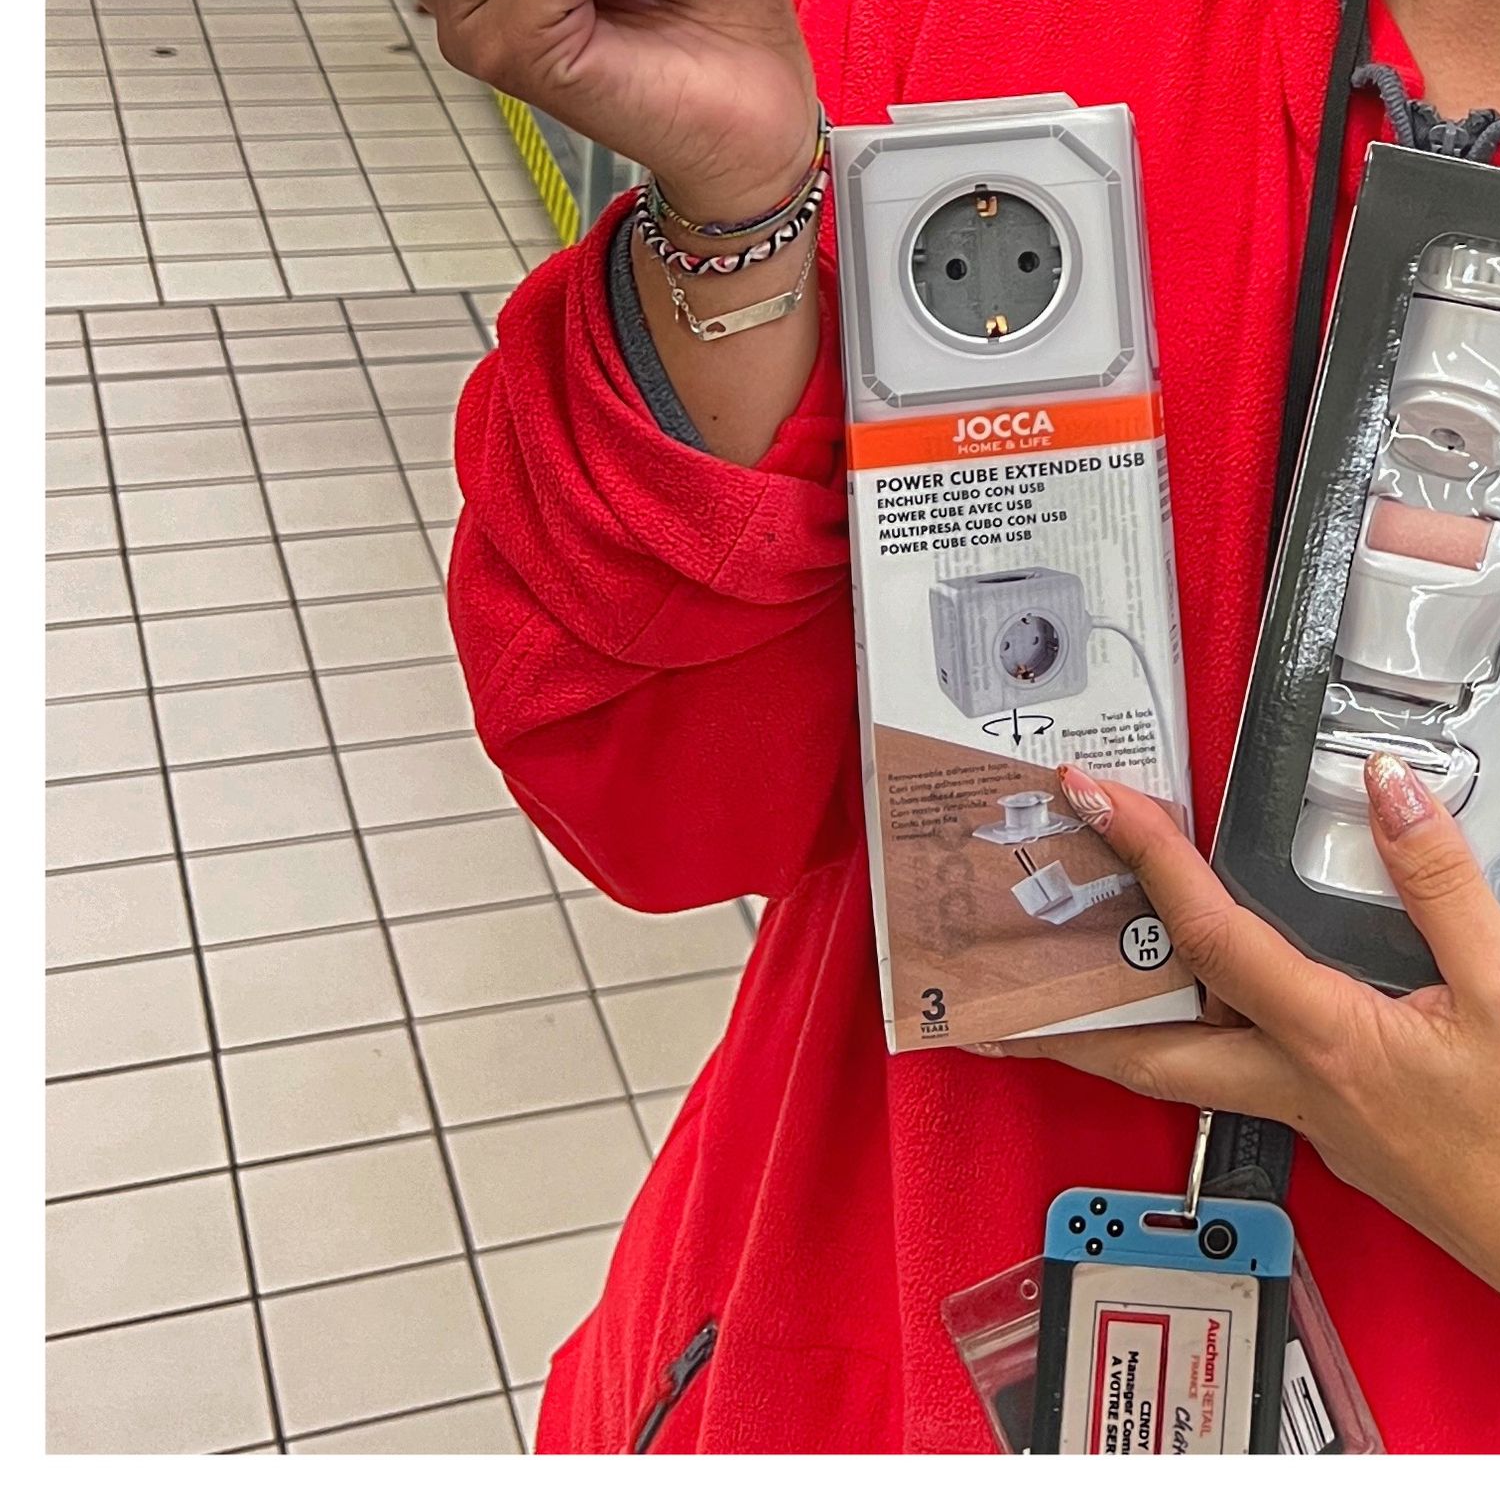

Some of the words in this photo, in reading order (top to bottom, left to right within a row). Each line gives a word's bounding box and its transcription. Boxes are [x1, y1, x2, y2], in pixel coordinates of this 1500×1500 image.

[952, 410, 1054, 443] JOCCA
[957, 441, 1002, 455] HOME
[1006, 439, 1015, 449] &
[1019, 435, 1052, 448] LIFE
[876, 473, 945, 494] POWER
[949, 466, 999, 486] CUBE
[1005, 456, 1102, 480] EXTENDED
[1108, 451, 1145, 470] USB
[877, 493, 939, 509] ENCHUFE
[942, 489, 981, 502] CUBO
[985, 485, 1015, 499] CON
[1019, 482, 1046, 495] USB
[878, 510, 927, 525] POWER
[930, 505, 965, 519] CUBE
[968, 502, 1003, 515] AVEC
[1006, 498, 1033, 511] USB
[878, 521, 962, 541] MULTIPRESA
[965, 516, 1003, 531] CUBO
[1007, 513, 1037, 527] CON
[1041, 510, 1068, 523] USB
[880, 541, 929, 556] POWER
[932, 536, 967, 550] CUBE
[970, 533, 1002, 546] COM
[1006, 529, 1033, 542] USB
[1101, 712, 1123, 721] Twist
[1131, 925, 1160, 947] 1,5
[1139, 946, 1158, 961] m
[921, 988, 946, 1021] 3
[920, 1024, 949, 1032] YEARS
[1112, 1356, 1122, 1366] A
[1205, 1318, 1220, 1382] Auchan
[1108, 1371, 1122, 1420] VOTRE
[1123, 1351, 1139, 1415] Manager
[1138, 1401, 1151, 1450] CINDY
